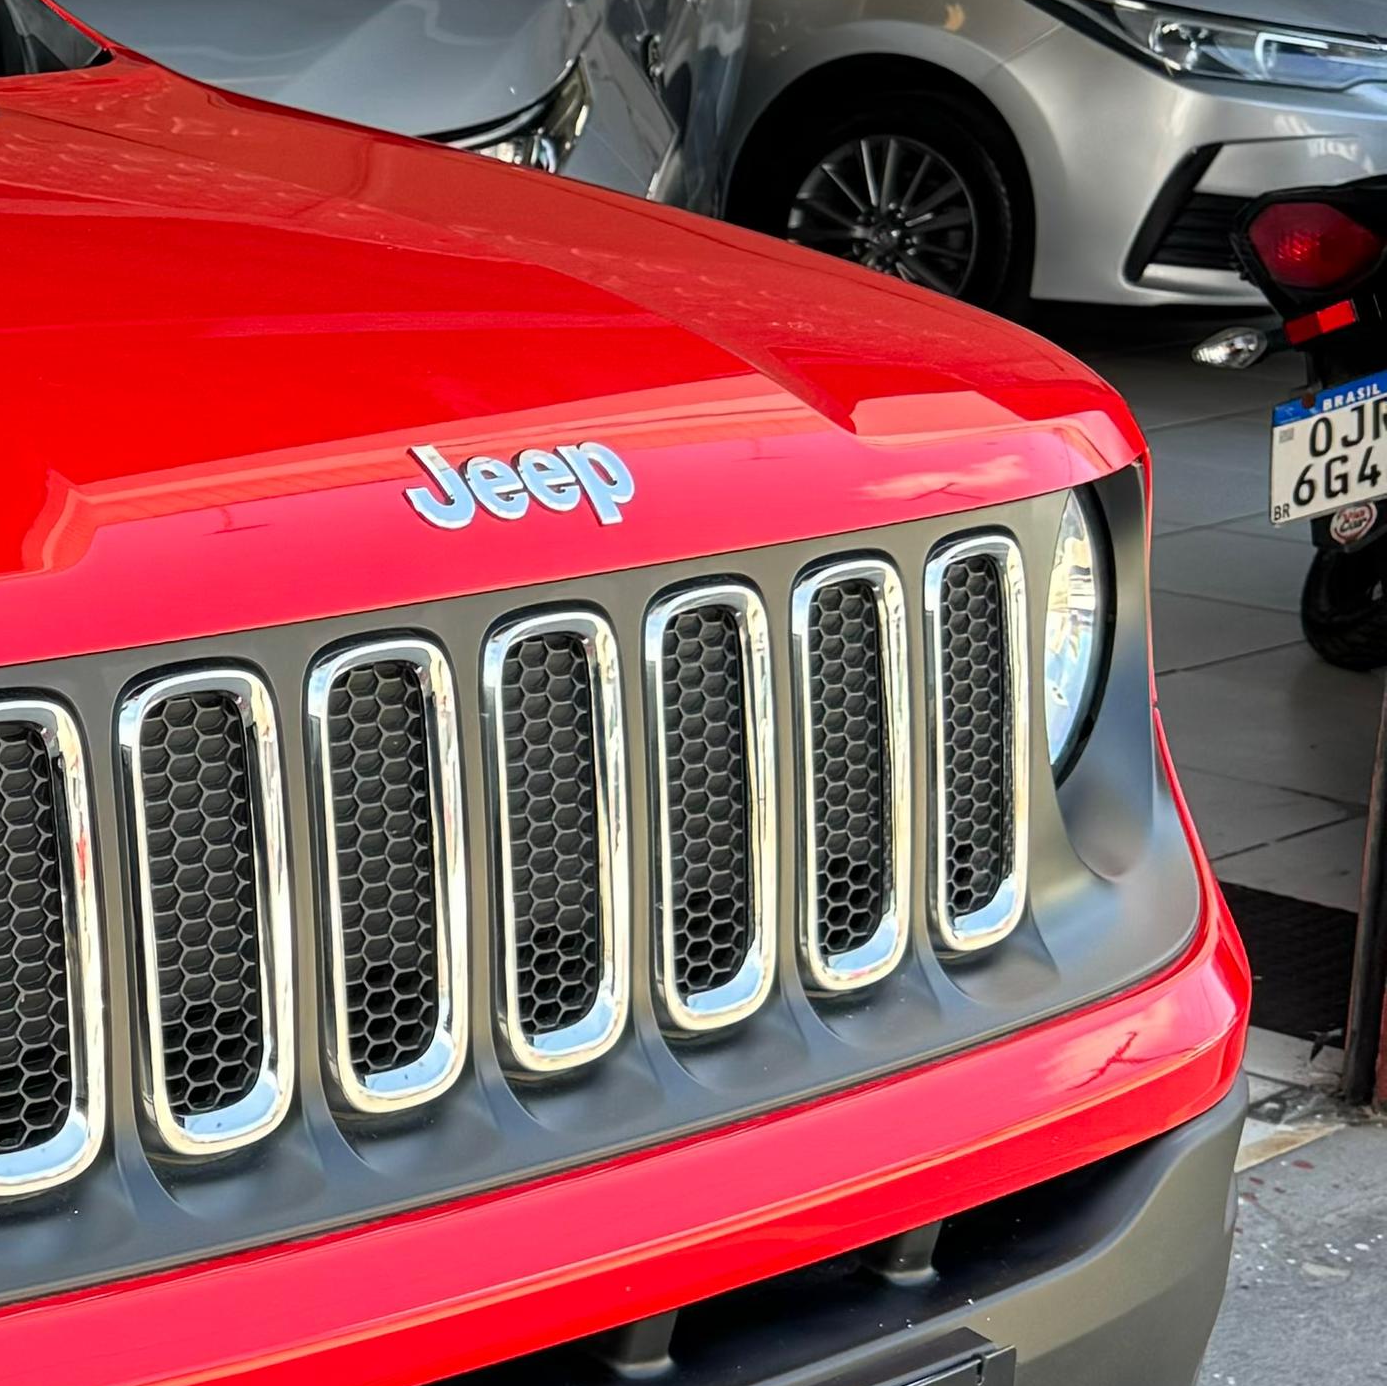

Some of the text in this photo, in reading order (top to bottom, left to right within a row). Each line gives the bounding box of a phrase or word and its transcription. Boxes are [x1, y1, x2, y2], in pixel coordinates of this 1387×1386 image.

[1322, 383, 1381, 411] BRASIL
[402, 441, 635, 530] Jeep
[1274, 503, 1290, 521] BR
